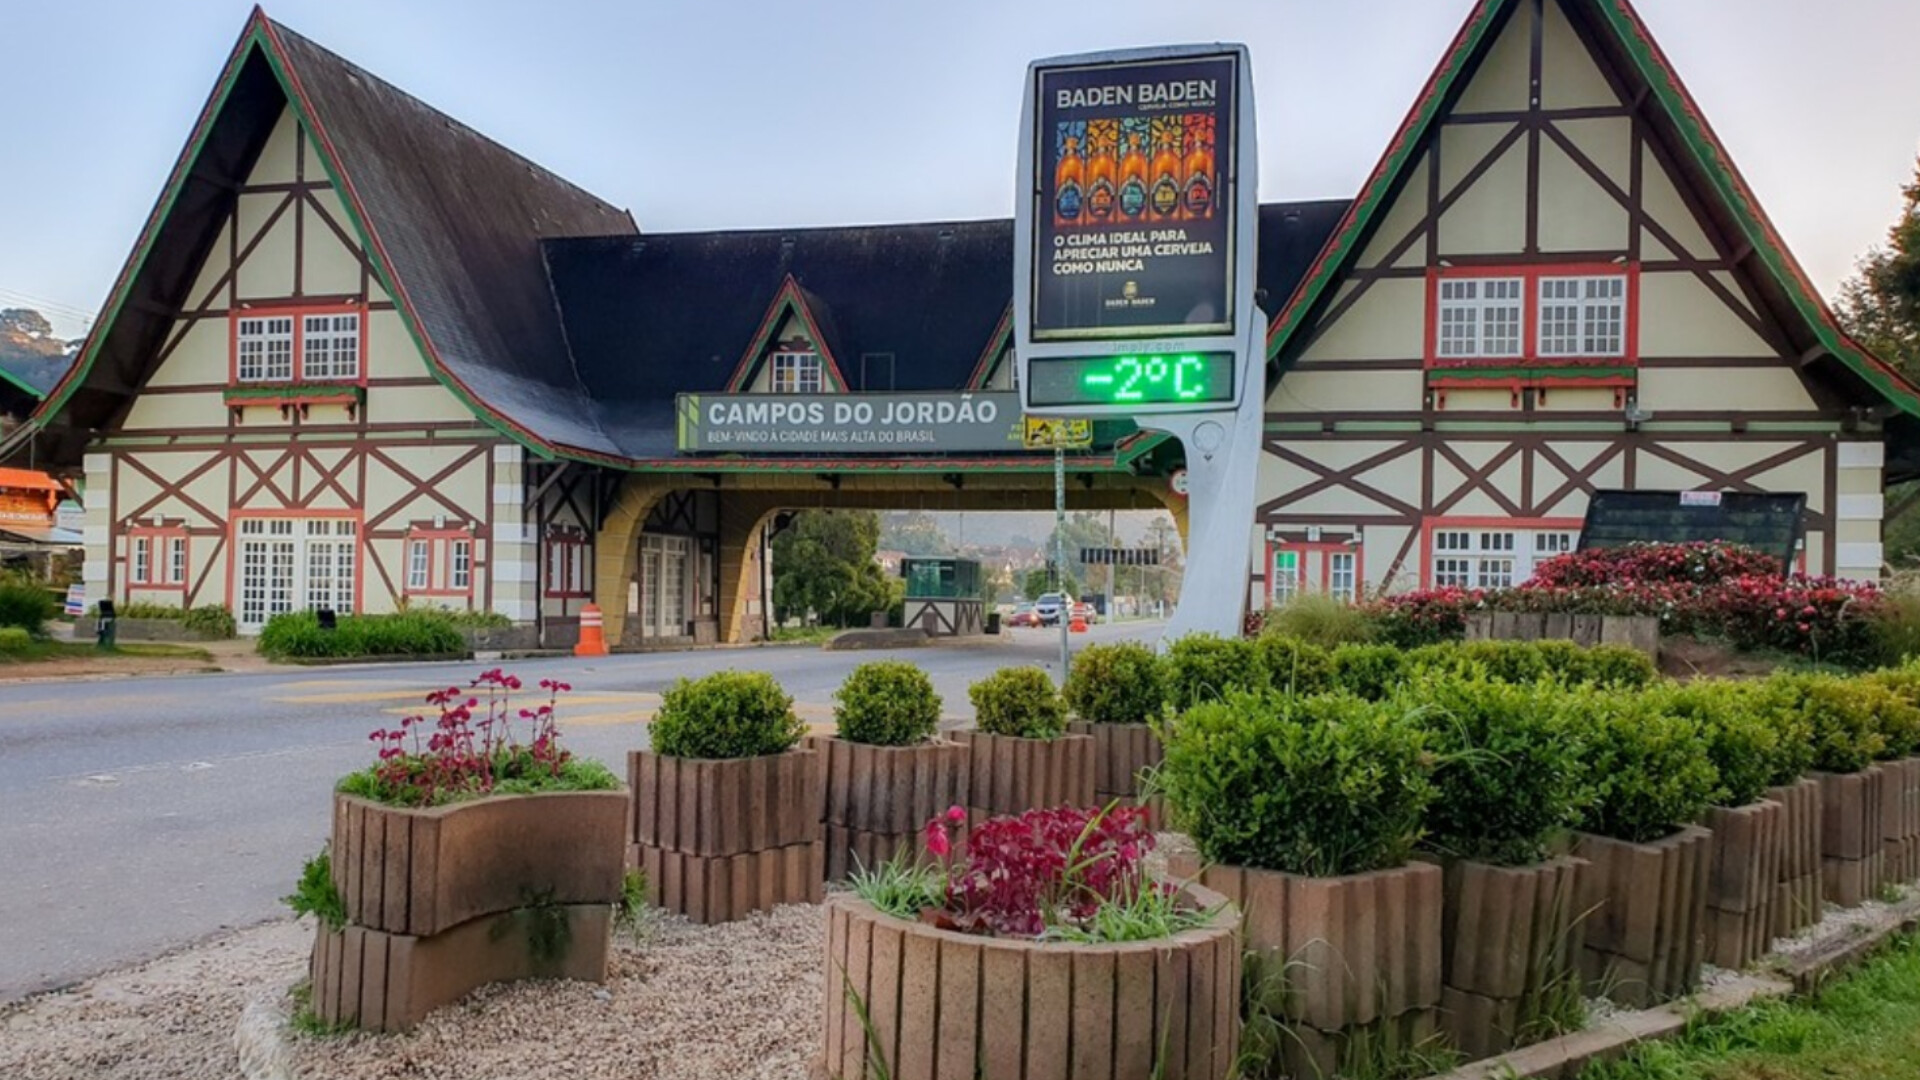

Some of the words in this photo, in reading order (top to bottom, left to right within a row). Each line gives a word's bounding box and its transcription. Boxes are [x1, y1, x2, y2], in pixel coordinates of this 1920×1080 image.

[1056, 85, 1133, 108] BADEN
[1138, 80, 1217, 103] BADEN
[1053, 235, 1065, 247] O
[1067, 233, 1107, 246] CLIMA
[1109, 231, 1148, 245] IDEAL
[1150, 229, 1187, 243] PARA
[1053, 247, 1119, 262] APRECIAR
[1121, 245, 1152, 258] UMA
[1153, 242, 1213, 256] CERVEJA
[1053, 261, 1094, 275] COMO
[1096, 260, 1144, 273] NUNCA
[708, 402, 825, 425] CAMPOS
[834, 402, 873, 424] DO
[880, 393, 998, 425] JORDÃO
[707, 429, 769, 443] BEM-VINDO
[769, 427, 779, 442] À
[780, 429, 819, 443] CIDADE
[820, 429, 848, 443] MAIS
[850, 429, 876, 443] ALTA
[878, 430, 893, 443] DO
[896, 429, 936, 443] BRASIL
